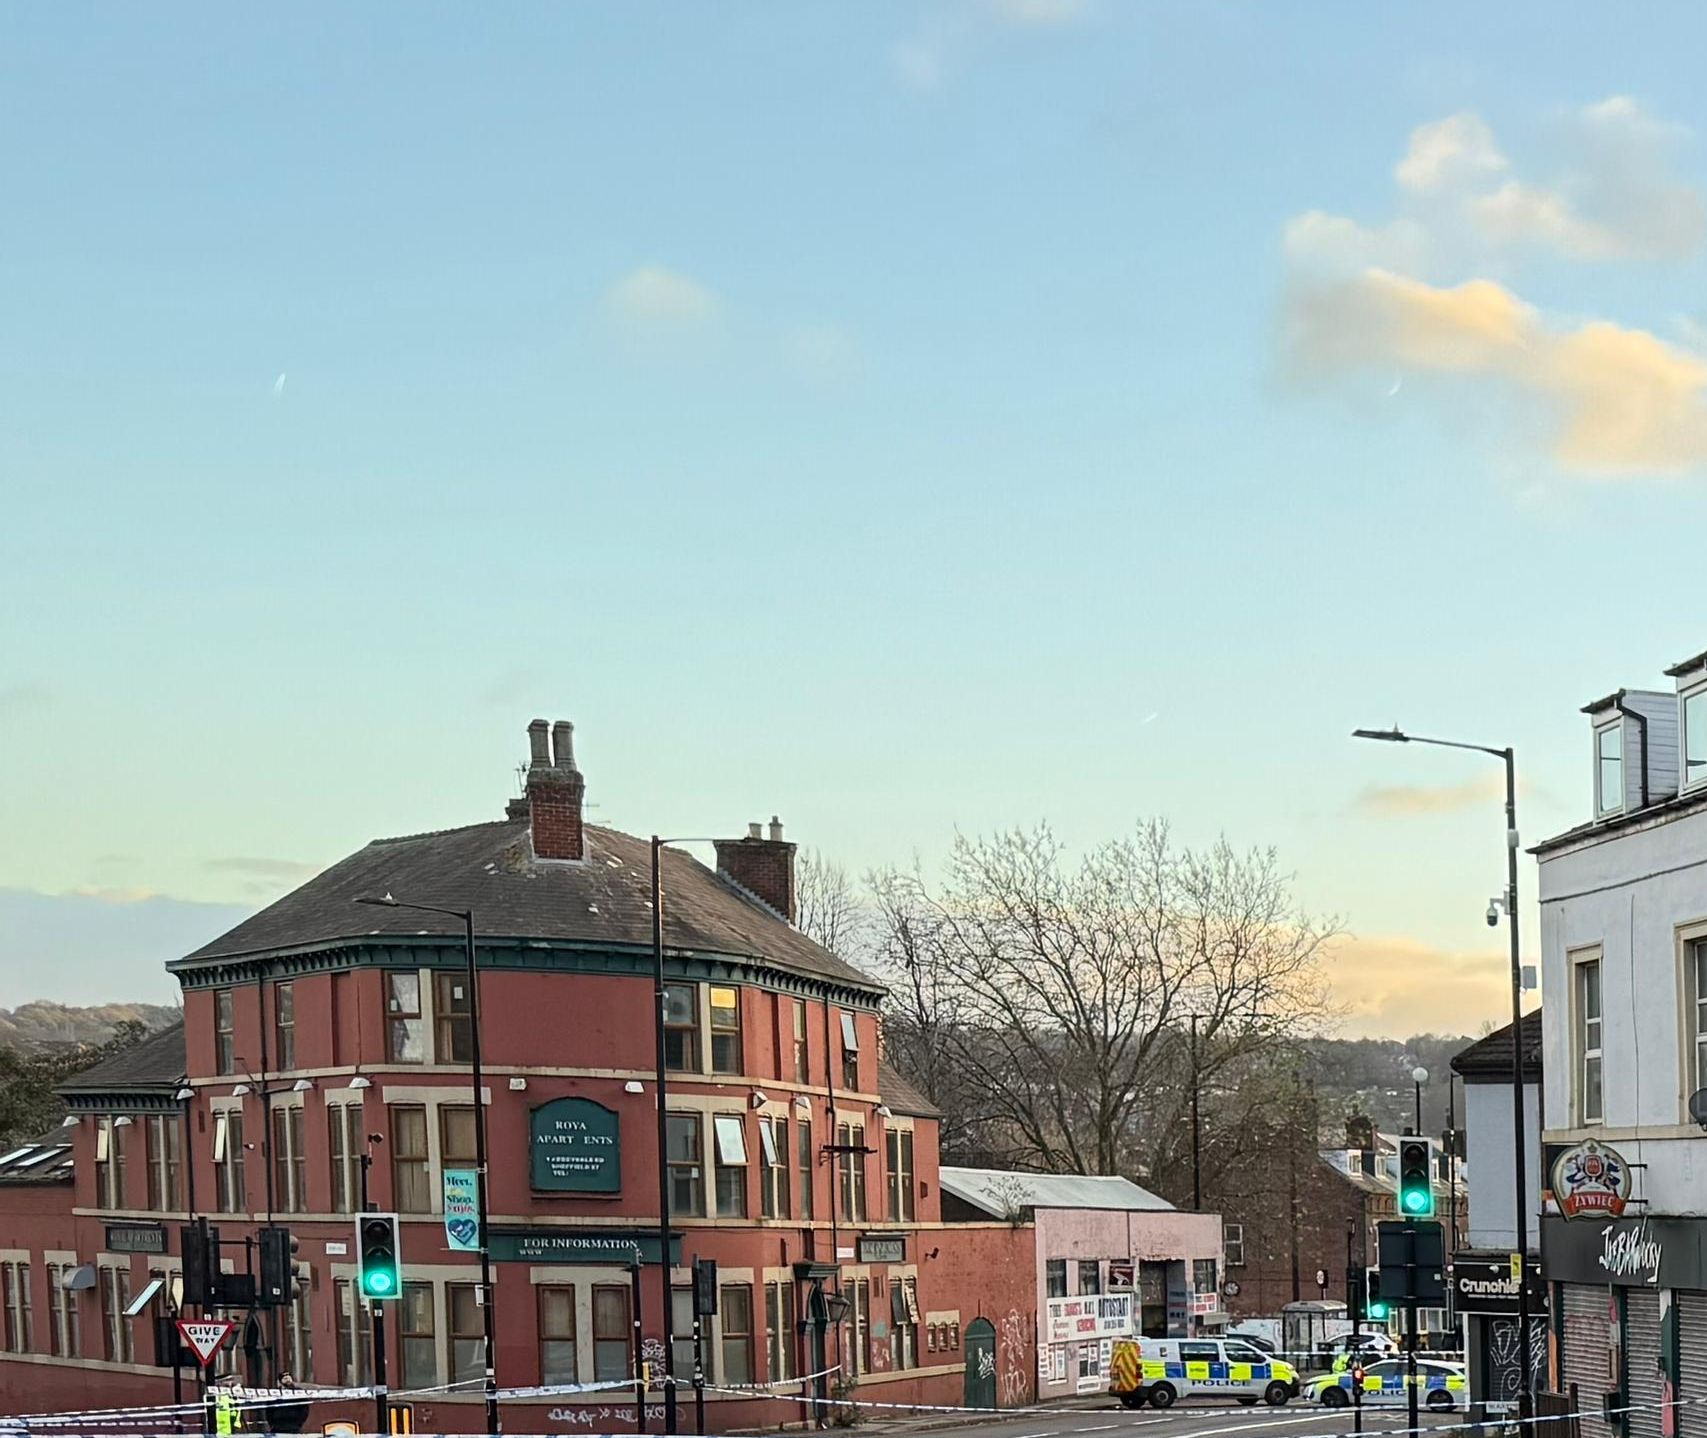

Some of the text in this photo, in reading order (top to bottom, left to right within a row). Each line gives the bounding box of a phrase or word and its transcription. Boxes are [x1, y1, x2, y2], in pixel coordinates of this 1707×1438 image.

[523, 1238, 639, 1250] FOR INFORMATION
[187, 1326, 222, 1336] GIVE
[195, 1337, 217, 1345] WAY
